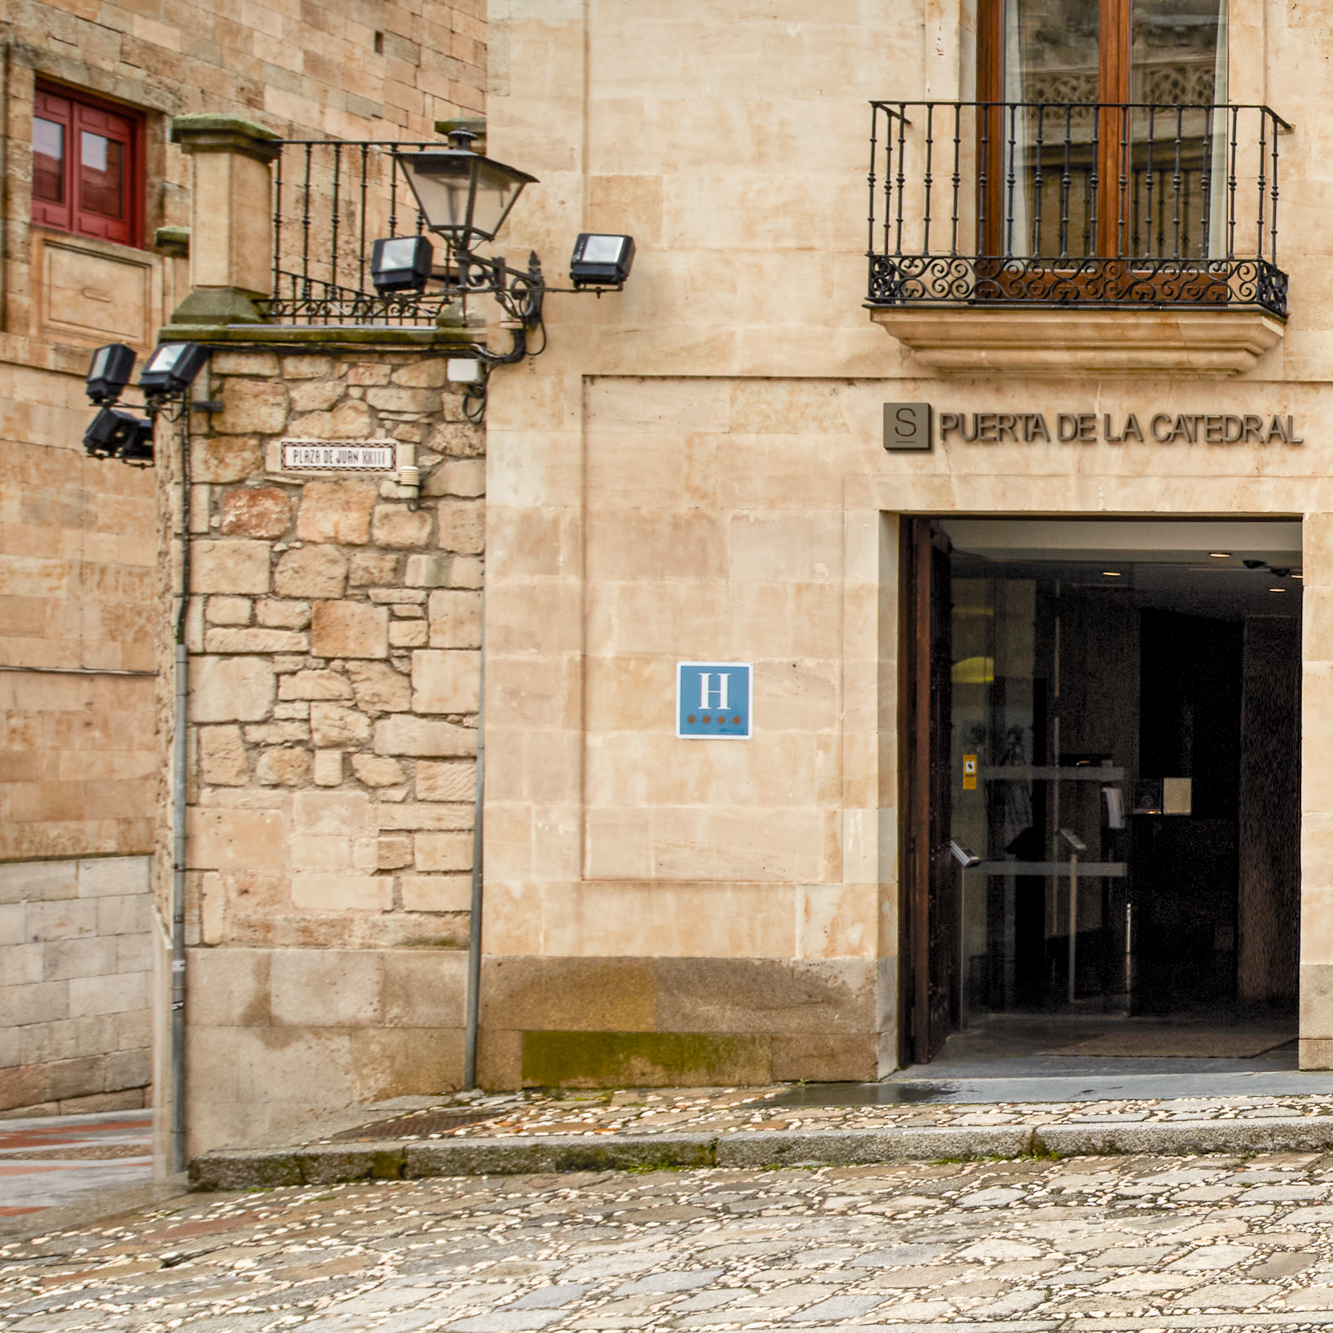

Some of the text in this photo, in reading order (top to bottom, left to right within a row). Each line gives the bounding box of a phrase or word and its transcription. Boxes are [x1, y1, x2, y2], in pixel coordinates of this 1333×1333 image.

[894, 407, 917, 437] S
[939, 412, 1304, 444] PUERTA DE LA CATEDRAL
[293, 449, 386, 465] PLAZA DE JUAN XXIII
[698, 672, 731, 710] H
